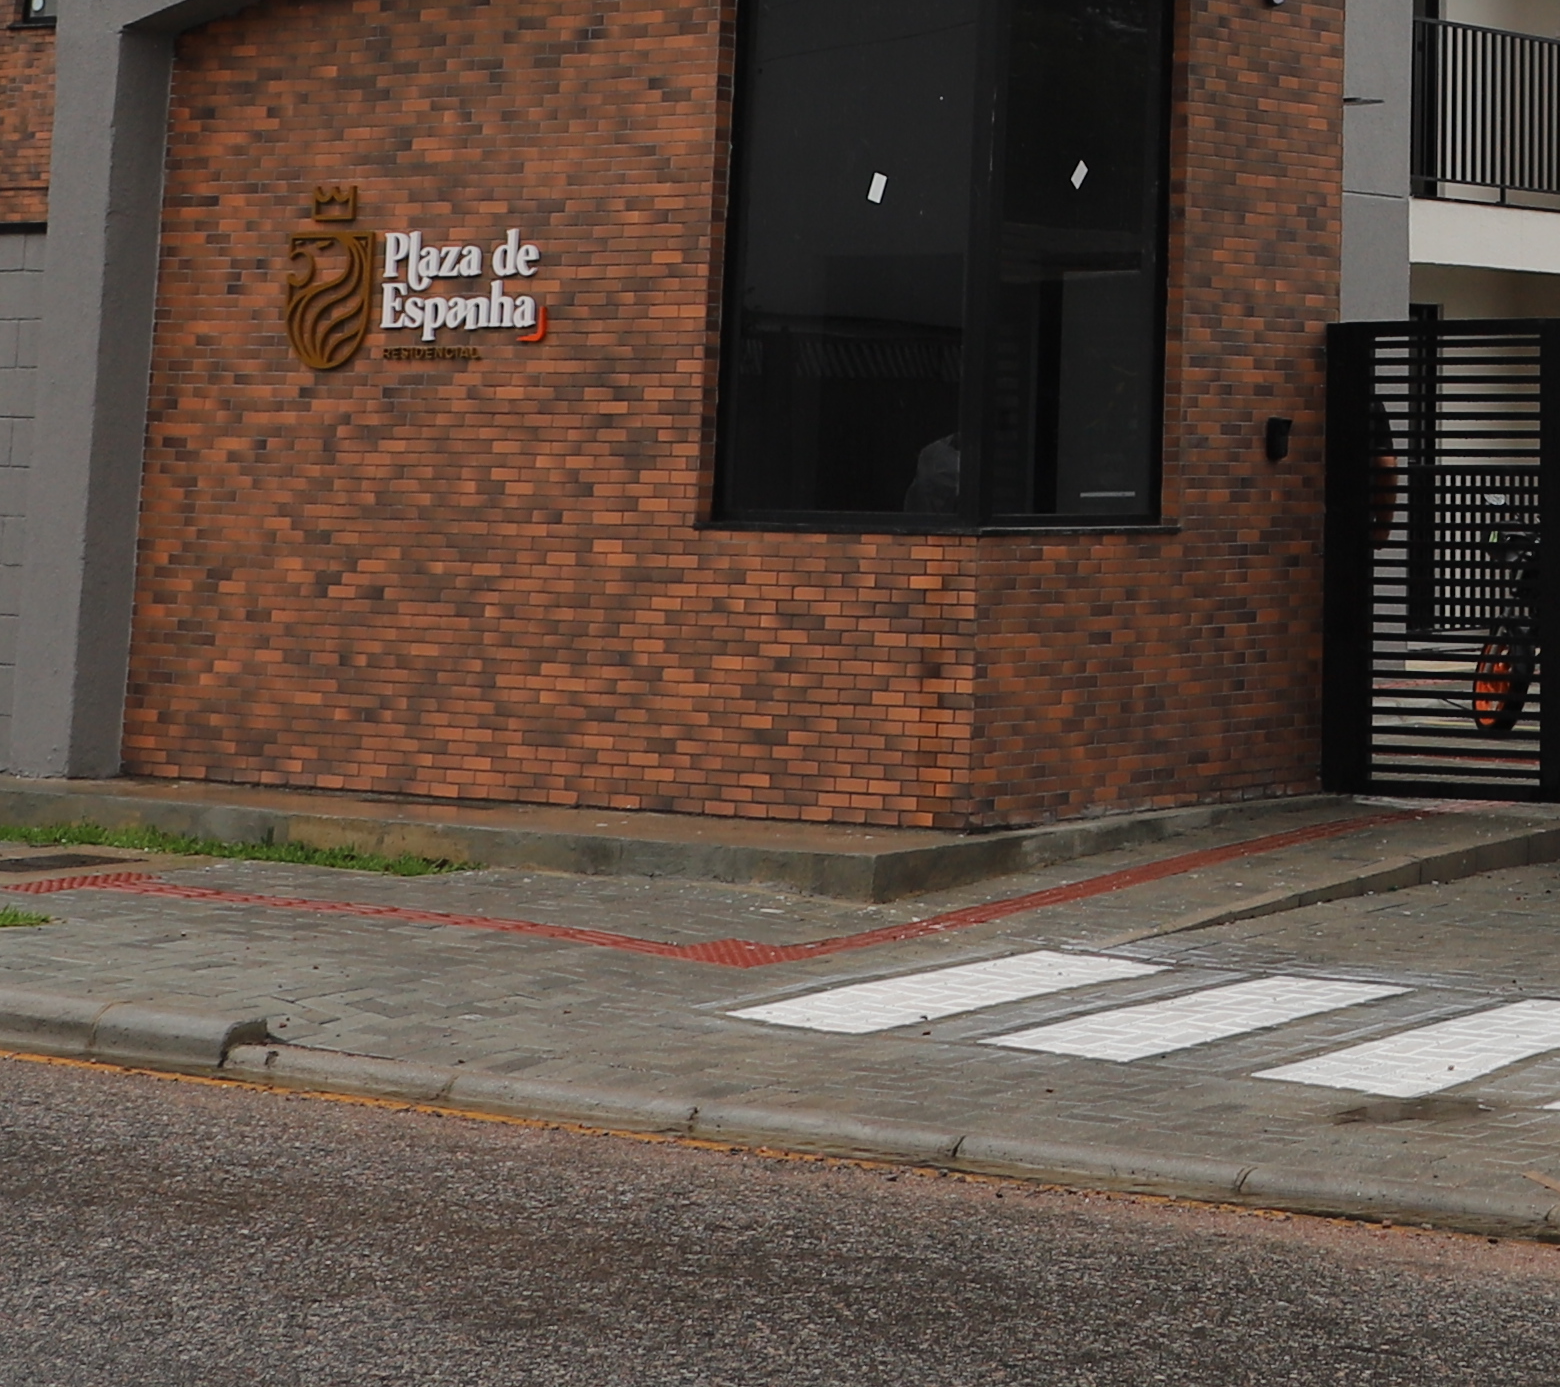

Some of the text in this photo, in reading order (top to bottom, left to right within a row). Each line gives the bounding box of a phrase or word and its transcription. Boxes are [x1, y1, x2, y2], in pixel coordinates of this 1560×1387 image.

[382, 228, 540, 291] Plaza de
[380, 279, 536, 342] Espanha
[382, 347, 482, 360] RESIDENCIAL
